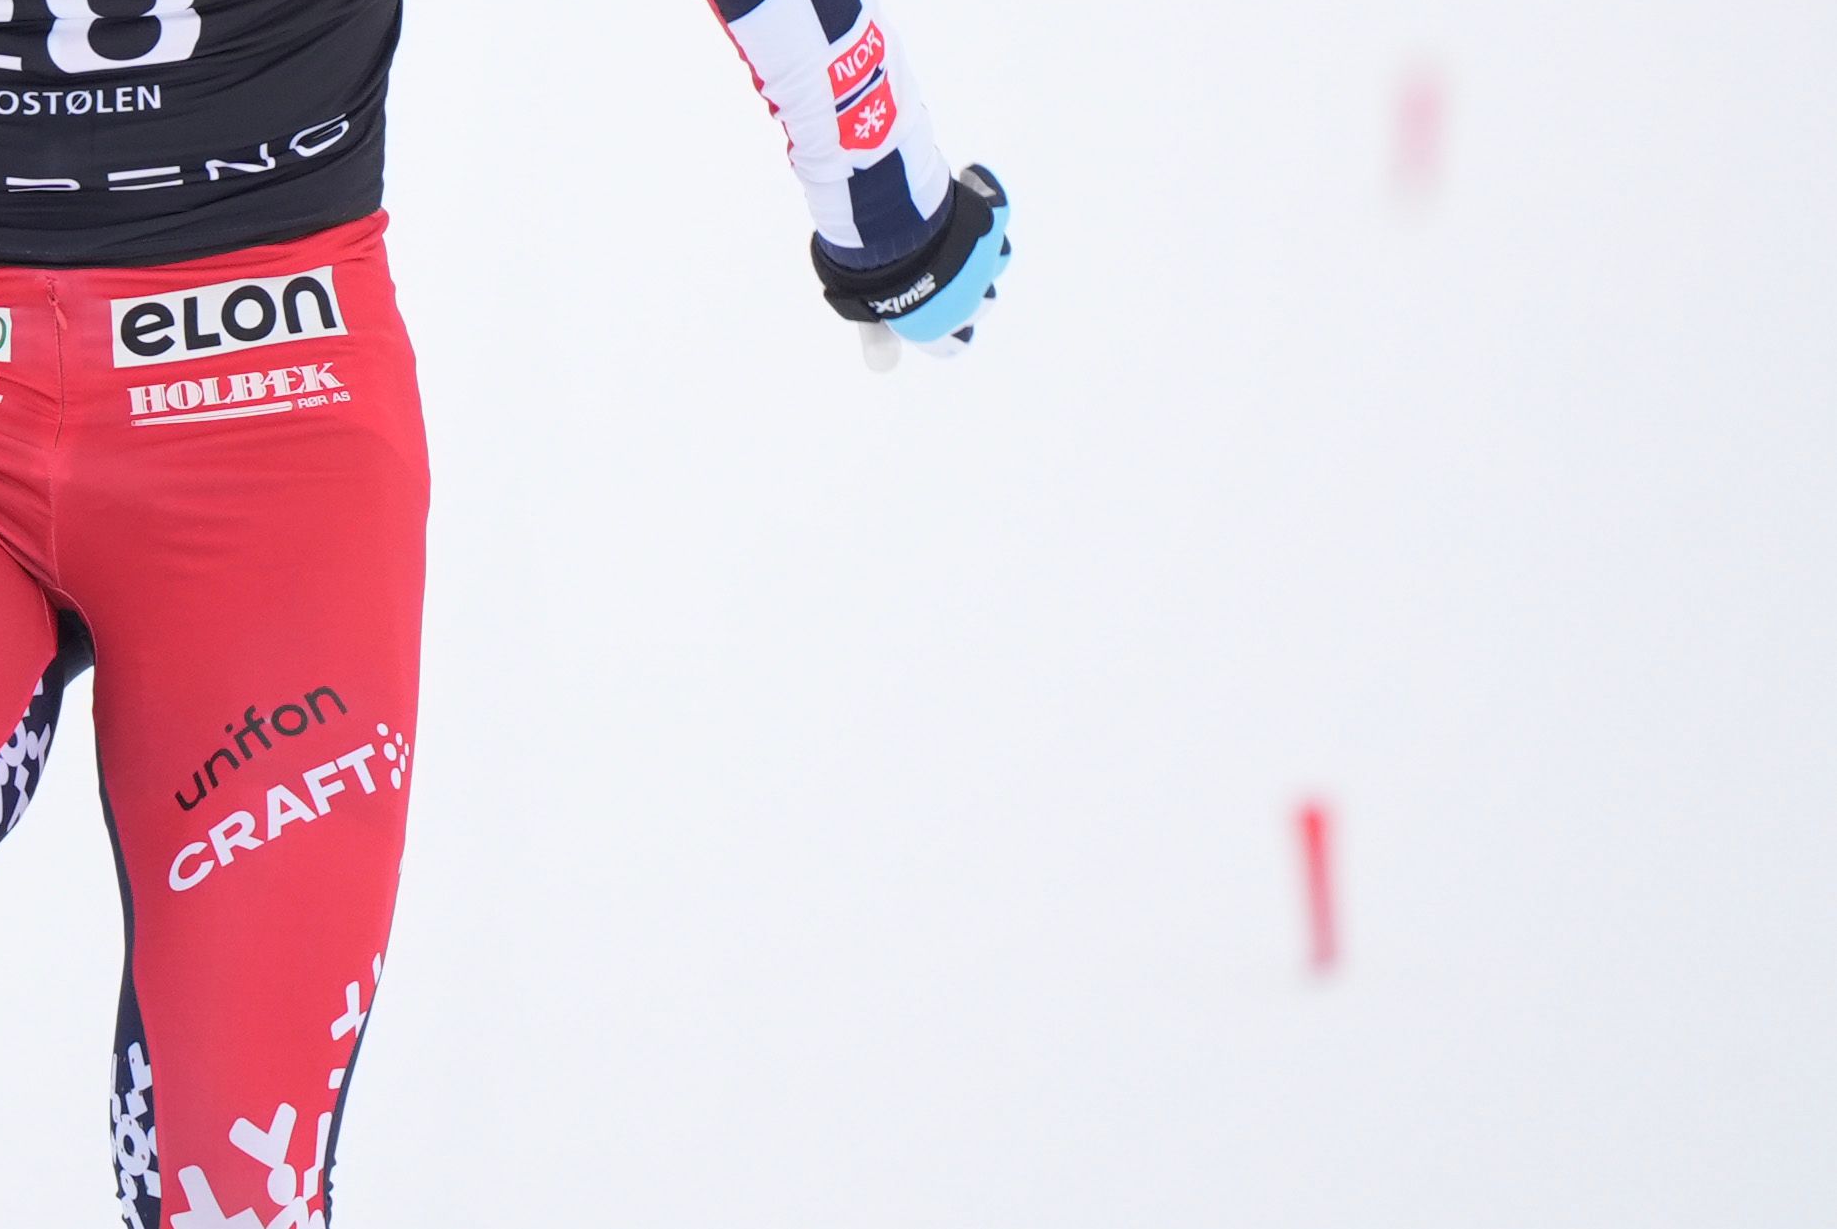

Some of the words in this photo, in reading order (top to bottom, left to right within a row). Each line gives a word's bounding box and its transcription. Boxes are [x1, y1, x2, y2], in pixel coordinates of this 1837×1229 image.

[834, 28, 882, 82] NOR
[127, 362, 345, 415] HOLBÆK
[297, 395, 329, 410] RØR
[333, 391, 351, 404] AS
[174, 686, 348, 811] unifon
[168, 743, 377, 892] CRAFT
